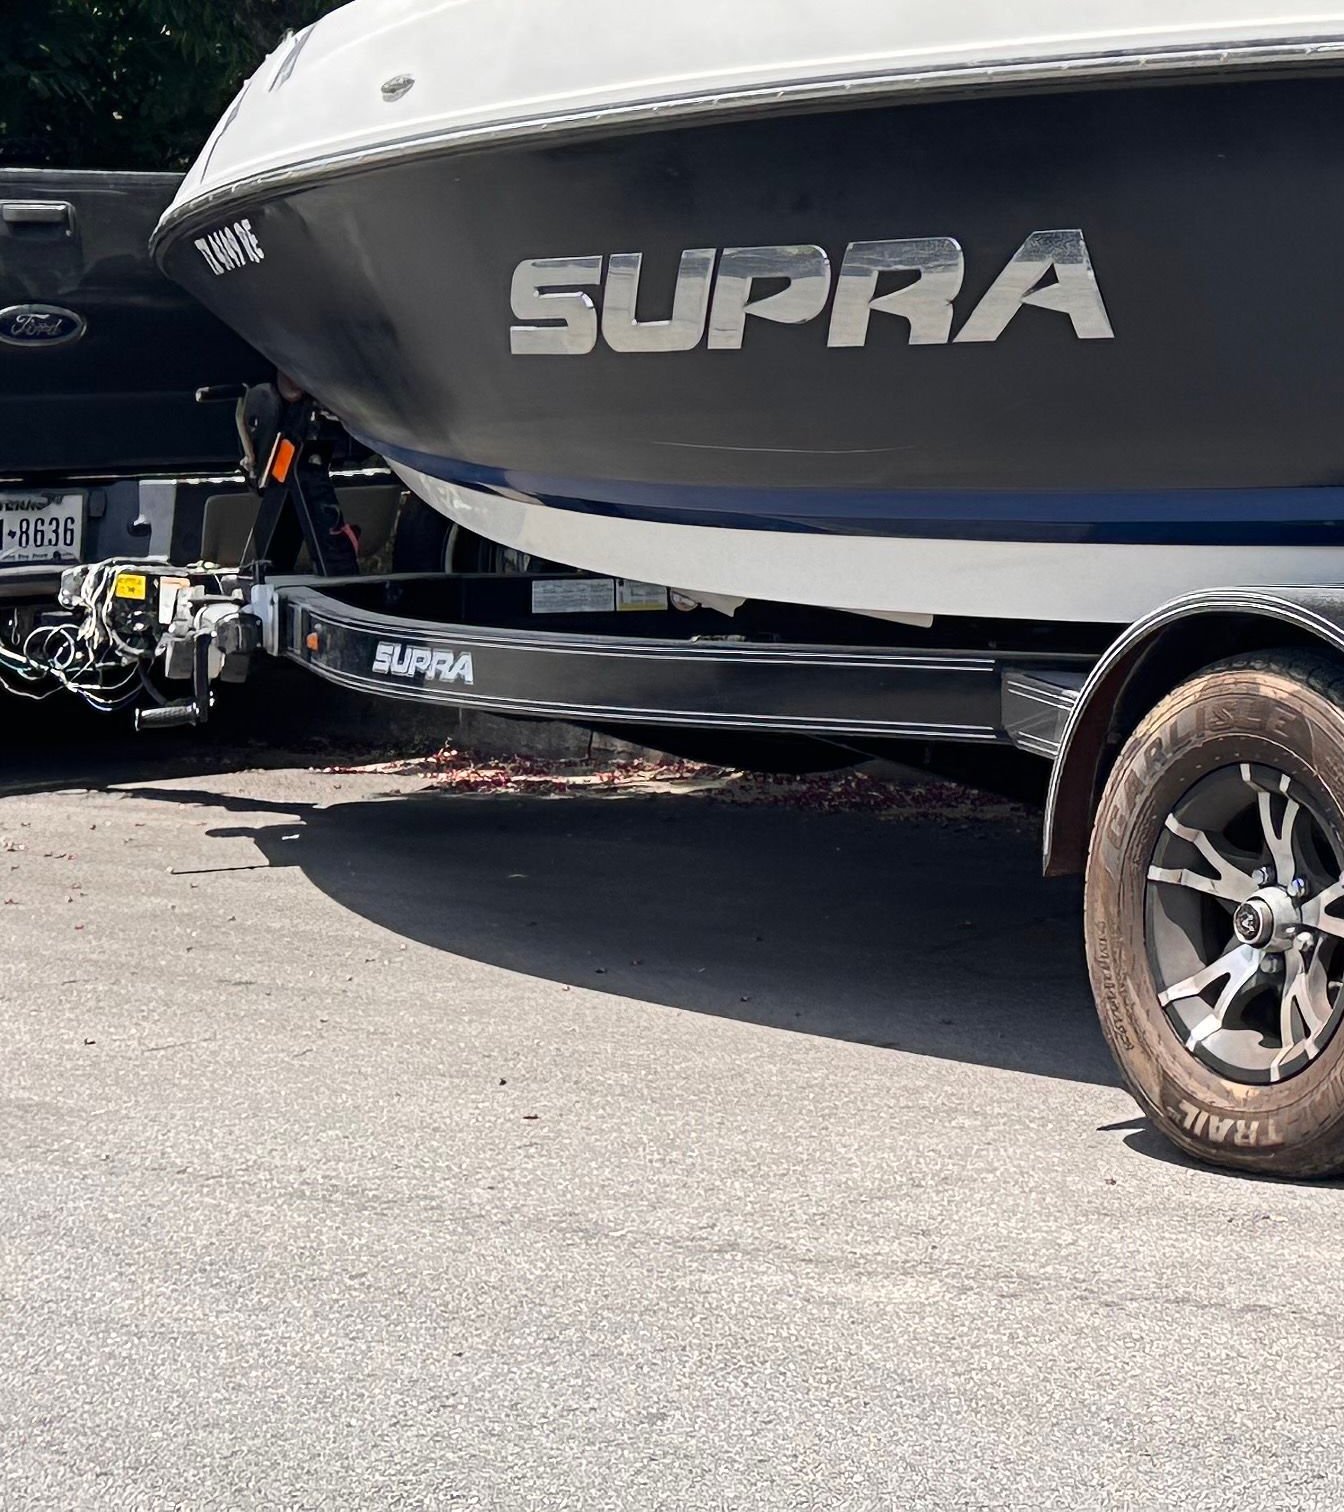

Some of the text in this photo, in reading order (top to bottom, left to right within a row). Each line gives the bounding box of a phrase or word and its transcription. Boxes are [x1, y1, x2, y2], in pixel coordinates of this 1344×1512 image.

[510, 229, 1115, 355] SUPRA
[10, 313, 64, 336] Ford
[372, 640, 475, 686] SUPRA
[1178, 1098, 1285, 1148] TRAIL
